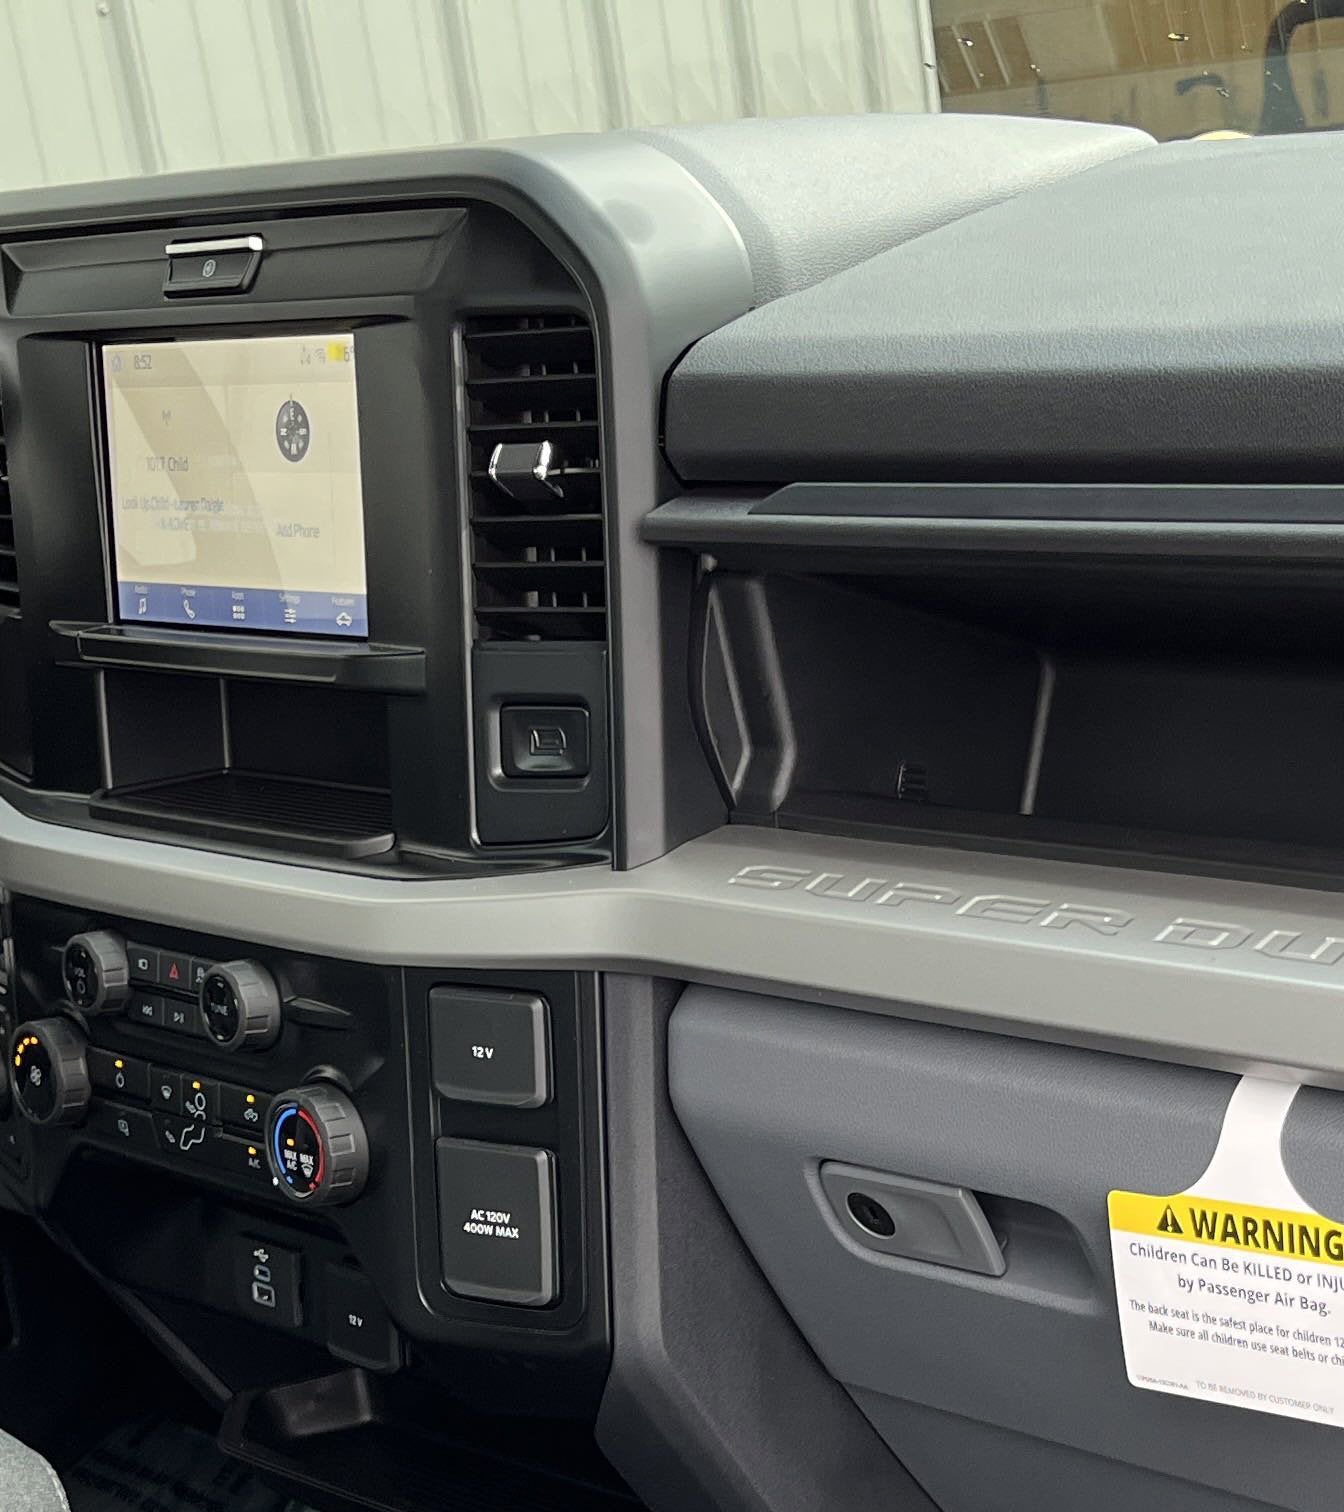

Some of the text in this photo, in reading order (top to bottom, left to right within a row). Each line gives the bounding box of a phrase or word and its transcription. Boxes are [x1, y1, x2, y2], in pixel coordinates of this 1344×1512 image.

[728, 864, 1132, 938] SUPER
[463, 1221, 520, 1239] 400W MAX
[471, 1208, 511, 1225] AC 120V
[1189, 1206, 1344, 1262] WARNING
[1129, 1241, 1187, 1264] Children
[1191, 1252, 1217, 1270] Can
[1221, 1258, 1239, 1273] Be
[1243, 1261, 1293, 1282] KILLED
[1297, 1273, 1312, 1285] or
[1177, 1274, 1331, 1317] by Passenger Air Bag.
[1128, 1299, 1146, 1312] The
[1147, 1301, 1169, 1316] back
[1170, 1307, 1190, 1321] seat
[1191, 1309, 1200, 1322] is
[1201, 1311, 1218, 1326] the
[1219, 1316, 1247, 1331] safest
[1249, 1321, 1274, 1336] place
[1275, 1325, 1290, 1339] for
[1292, 1328, 1332, 1347] children
[1148, 1320, 1174, 1336] Make
[1175, 1326, 1196, 1340] sure
[1197, 1329, 1209, 1342] all
[1211, 1331, 1249, 1350] children
[1250, 1340, 1268, 1353] use
[1269, 1343, 1290, 1356] seat
[1291, 1346, 1316, 1362] belts
[1317, 1353, 1329, 1364] or
